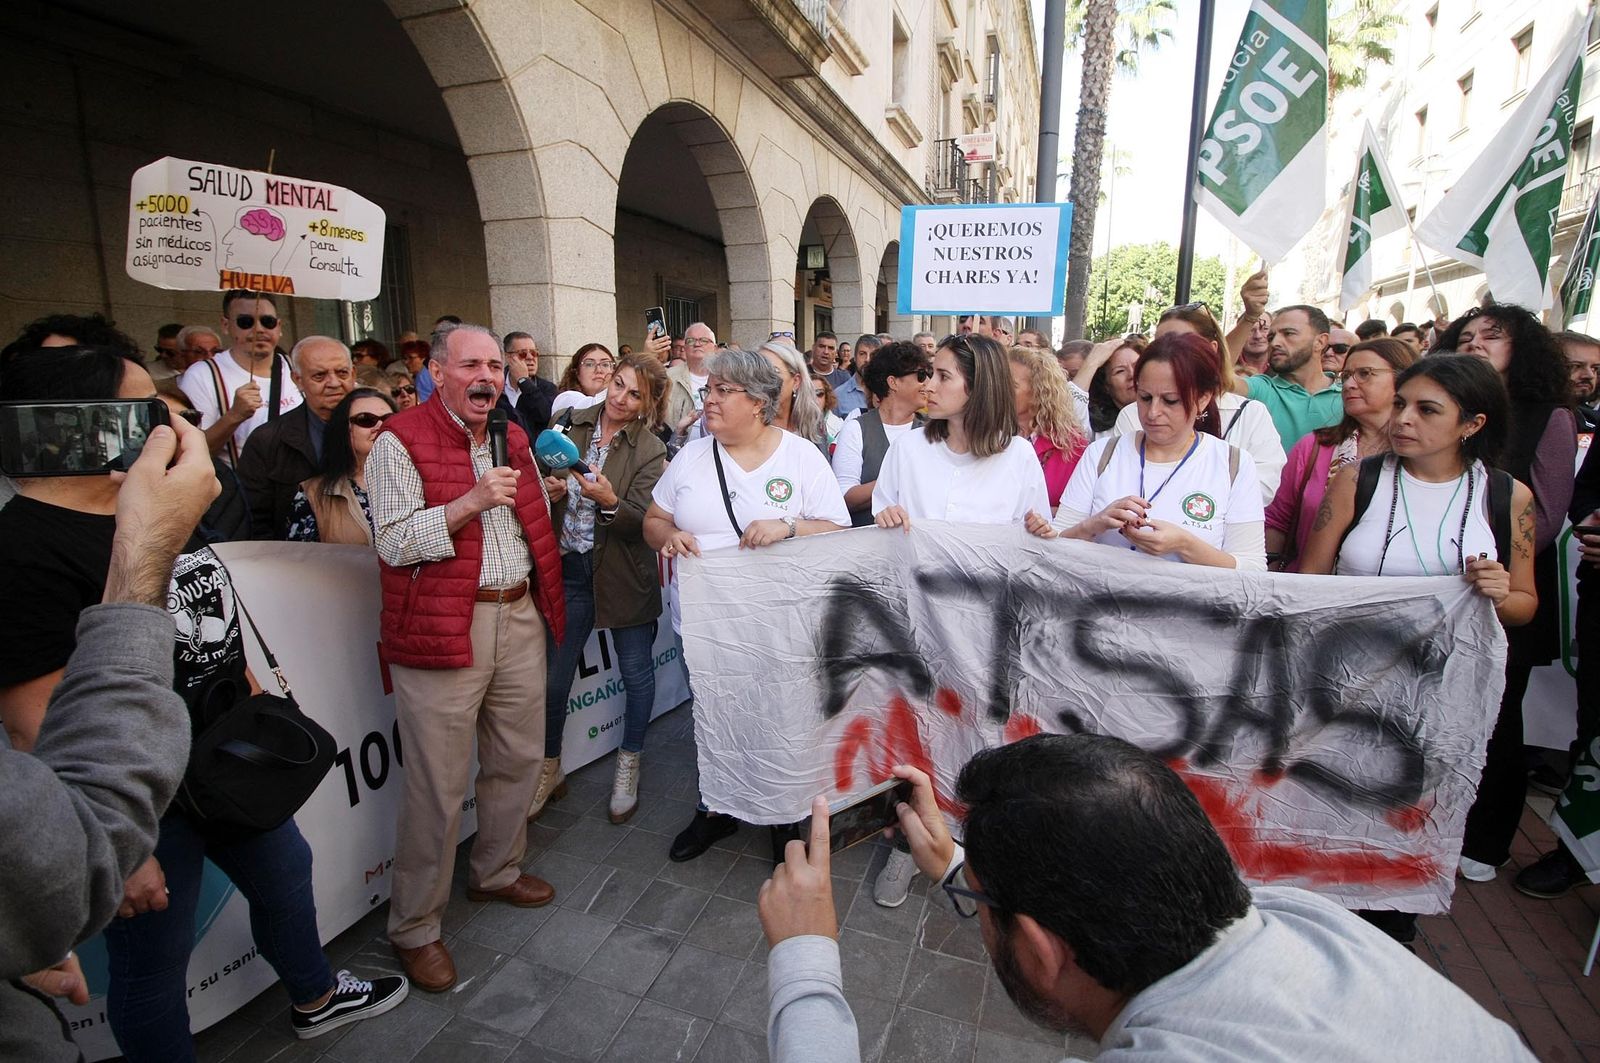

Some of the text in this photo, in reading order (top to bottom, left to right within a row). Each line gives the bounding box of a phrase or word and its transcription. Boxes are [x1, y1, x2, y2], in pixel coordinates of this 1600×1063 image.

[1197, 46, 1319, 187] PSOE
[188, 166, 338, 212] SALUD MENTAL
[136, 194, 189, 214] +5000
[139, 214, 203, 234] pacientes
[927, 221, 1042, 242] ¡QUEREMOS
[135, 235, 212, 252] sin médicos
[309, 240, 338, 255] para
[132, 253, 203, 270] asignados
[933, 245, 1033, 262] NUESTROS
[219, 269, 295, 295] HUELVA
[925, 269, 1038, 285] CHARES YA!
[199, 972, 219, 991] su
